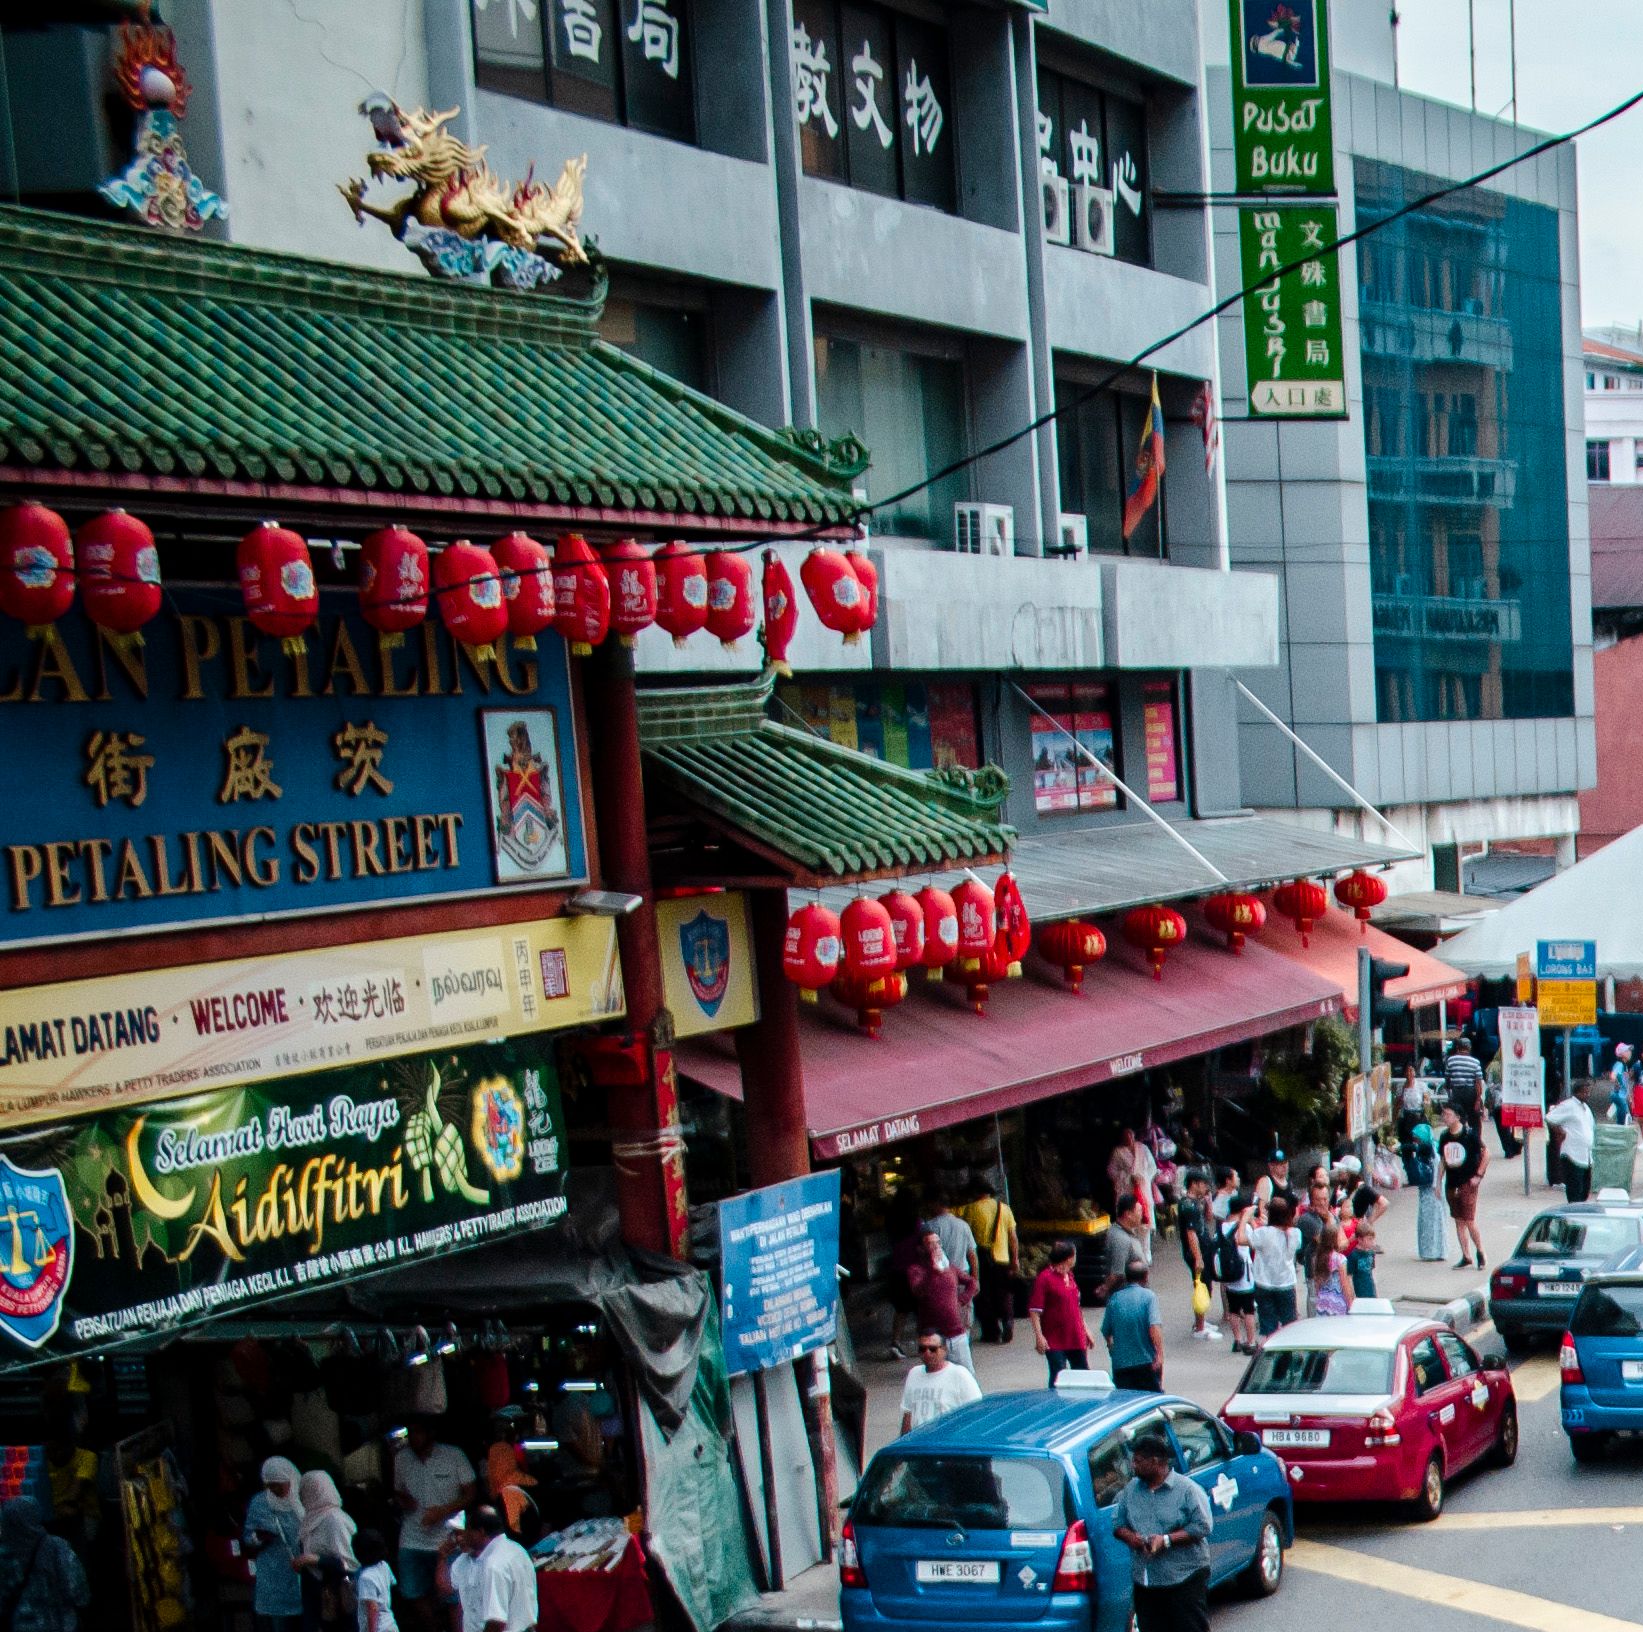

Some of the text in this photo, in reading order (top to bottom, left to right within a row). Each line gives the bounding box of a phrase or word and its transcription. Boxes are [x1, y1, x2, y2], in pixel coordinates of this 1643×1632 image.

[1300, 221, 1330, 367] 文殊書局
[8, 811, 465, 911] PETALING STREET
[190, 987, 290, 1036] WELCOME
[312, 976, 405, 1024] 欢迎光临
[71, 1006, 161, 1055] DATANG
[203, 1058, 262, 1079] ASSOCIATION
[155, 1094, 401, 1174] Selamat Hari Raya
[836, 1114, 920, 1151] SELAMAT DATANG
[179, 1145, 409, 1262] Aidilfitri
[460, 1214, 489, 1238] PETTY
[515, 1195, 568, 1223] ASSOCIATION
[74, 1305, 138, 1340] PERSATUAN
[136, 1295, 182, 1325] PENJAJA
[179, 1288, 204, 1313] DAN
[203, 1277, 250, 1307] PENIAGA
[249, 1270, 277, 1296] KECIL
[1272, 1431, 1292, 1442] HBA
[931, 1564, 985, 1577] HWE 3067
